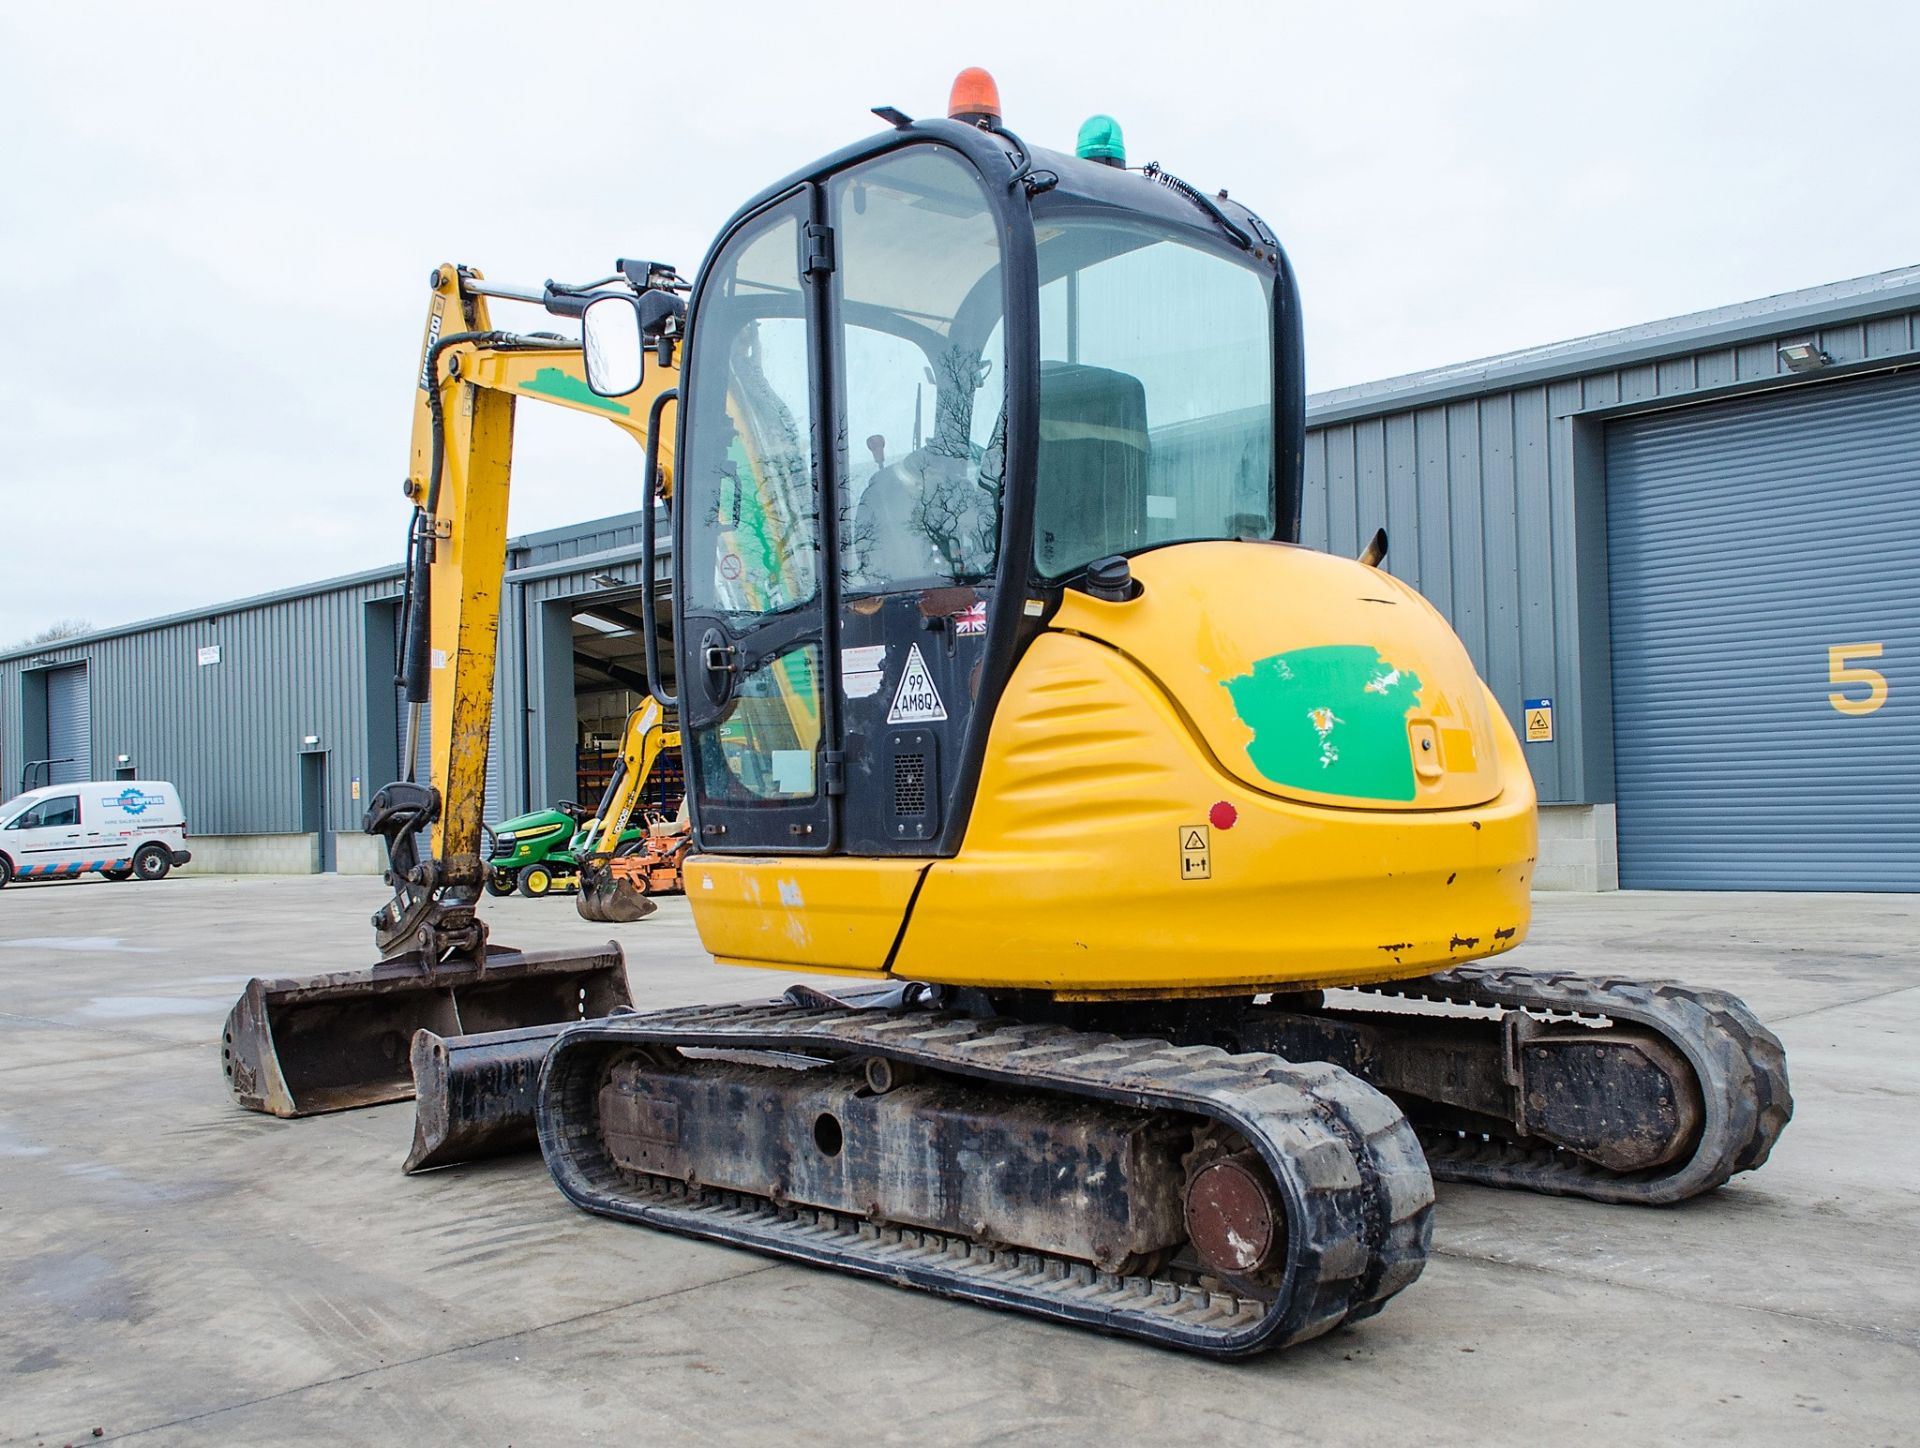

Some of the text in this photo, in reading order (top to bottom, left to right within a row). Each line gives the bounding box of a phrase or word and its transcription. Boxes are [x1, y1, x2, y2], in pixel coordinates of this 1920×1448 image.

[909, 674, 924, 692] 99
[1828, 642, 1889, 716] 5
[902, 693, 932, 713] AM8Q
